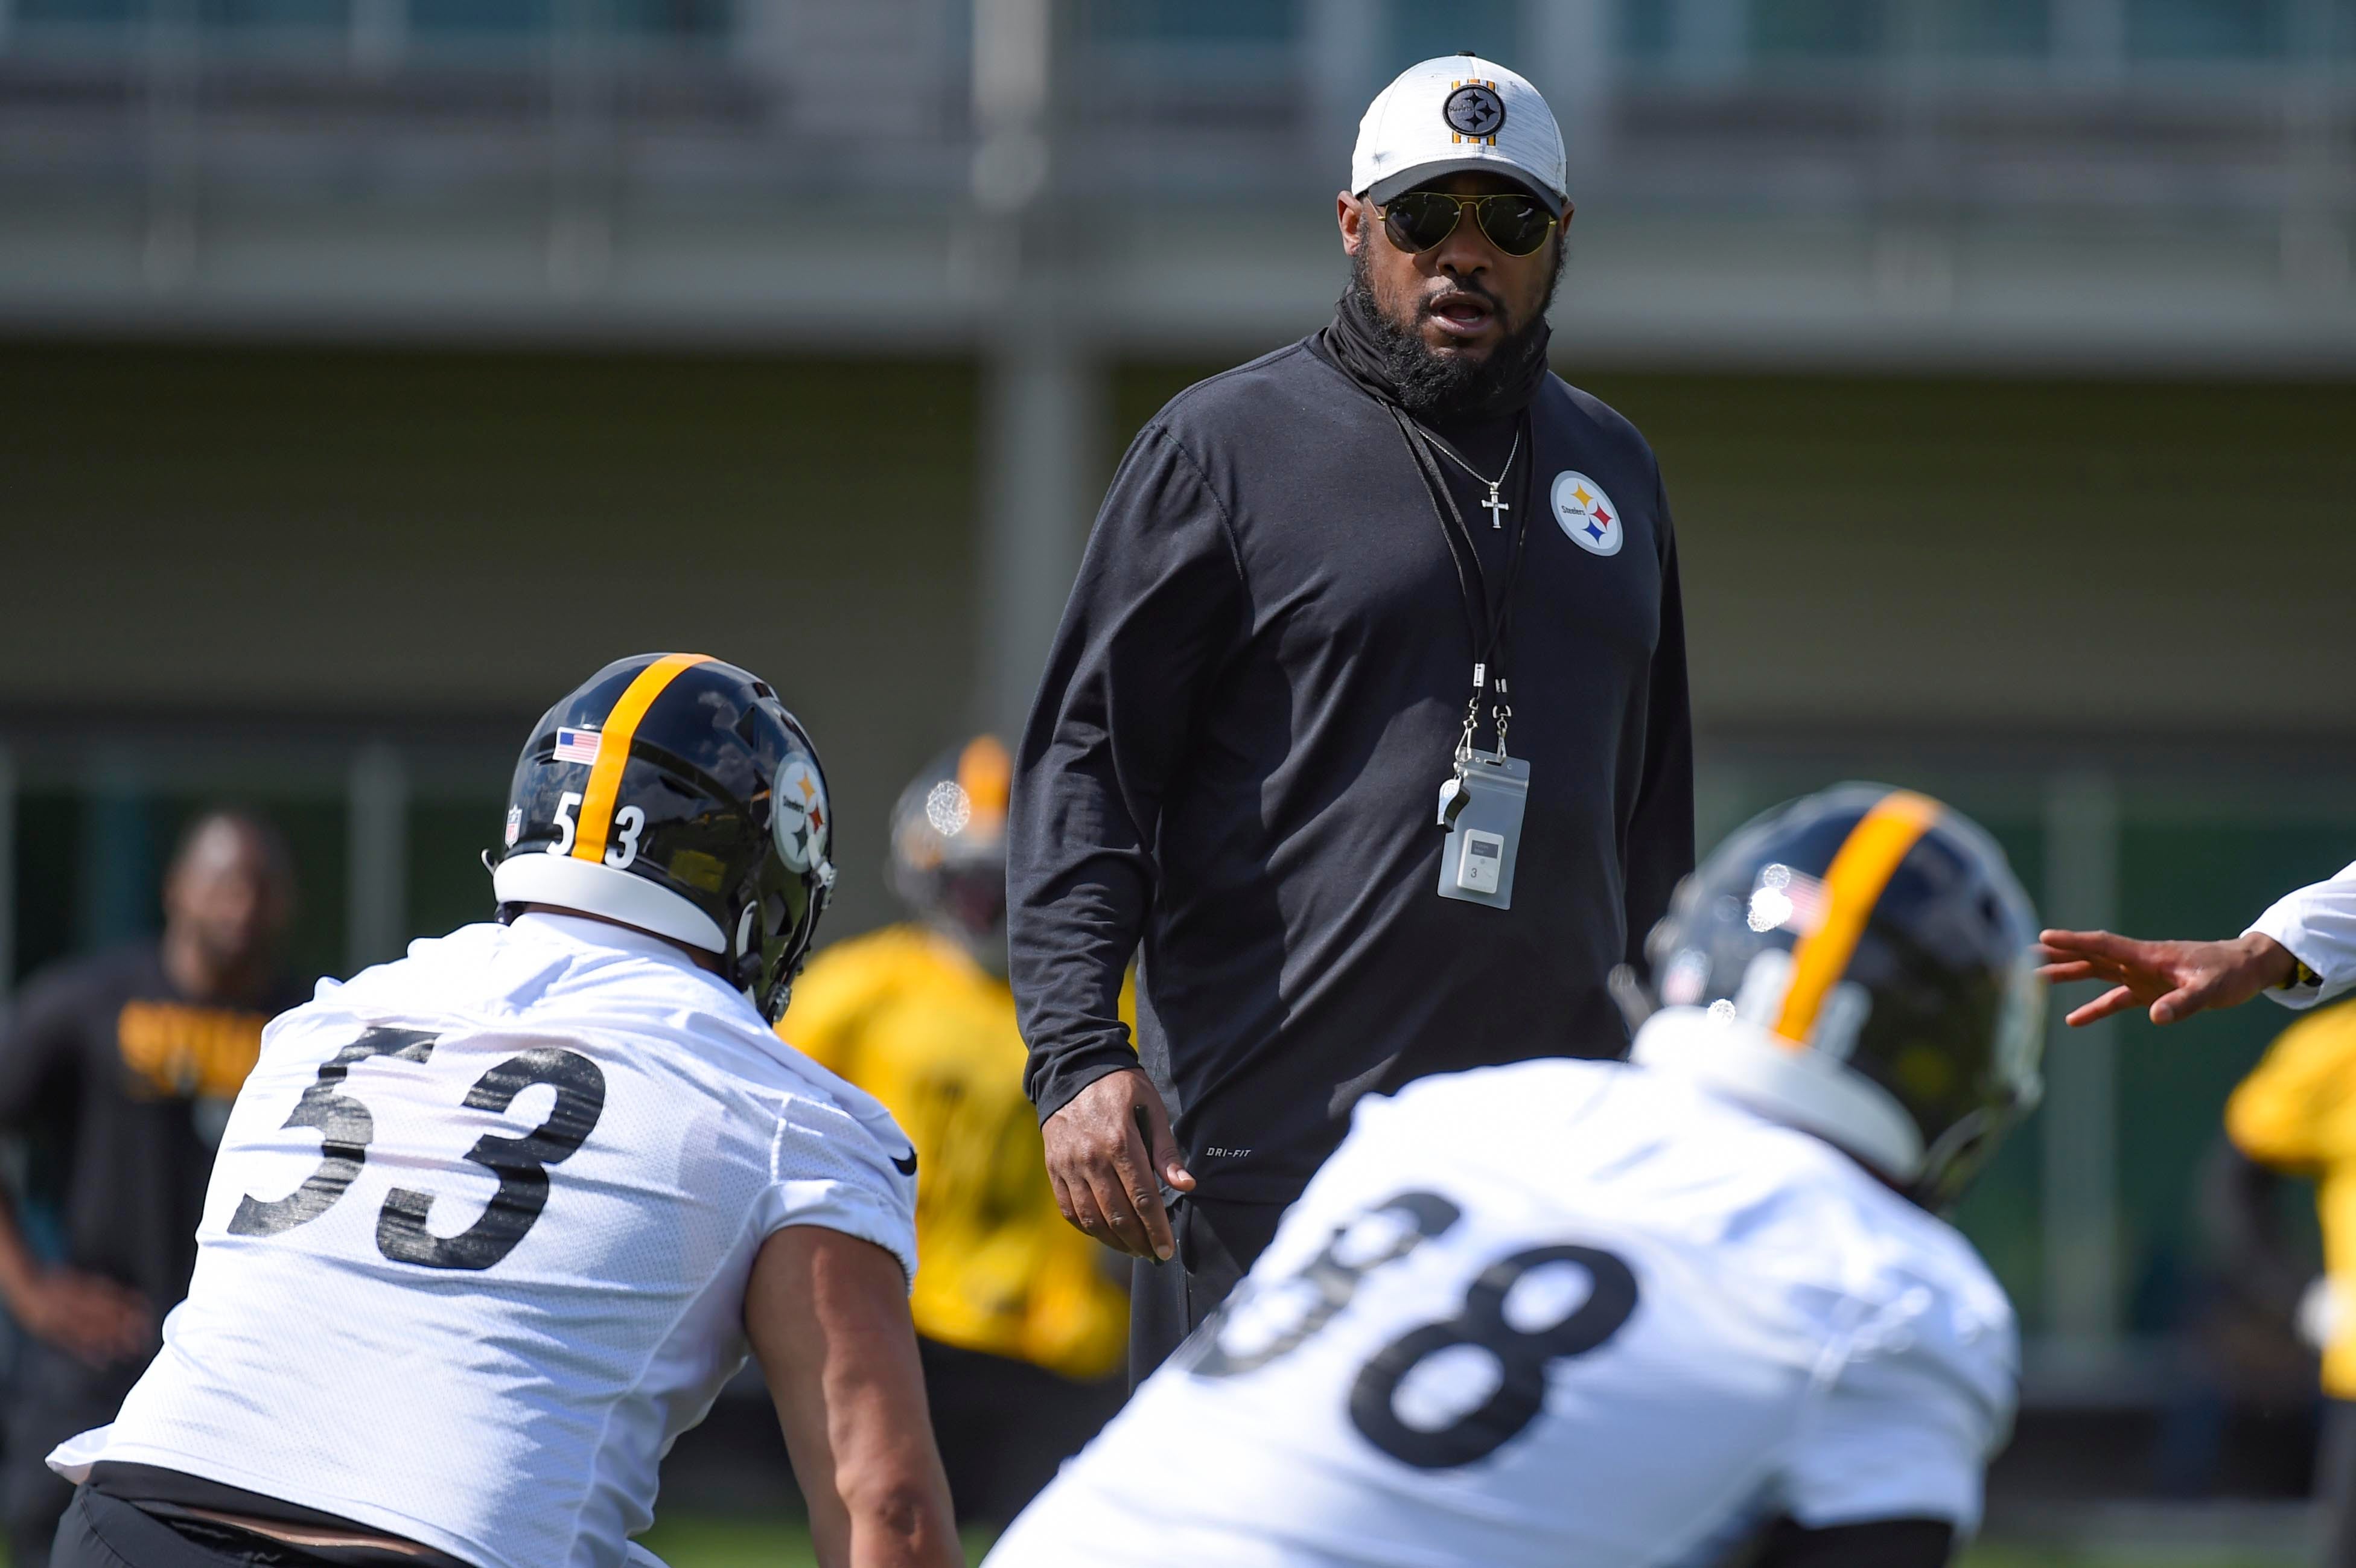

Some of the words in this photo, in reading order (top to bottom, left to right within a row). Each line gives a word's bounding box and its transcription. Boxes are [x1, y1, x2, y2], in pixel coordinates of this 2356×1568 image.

[1562, 505, 1585, 515] Steelers
[1471, 868, 1477, 878] 3
[227, 1026, 606, 1270] 53
[1206, 1147, 1251, 1157] DRI-FIT
